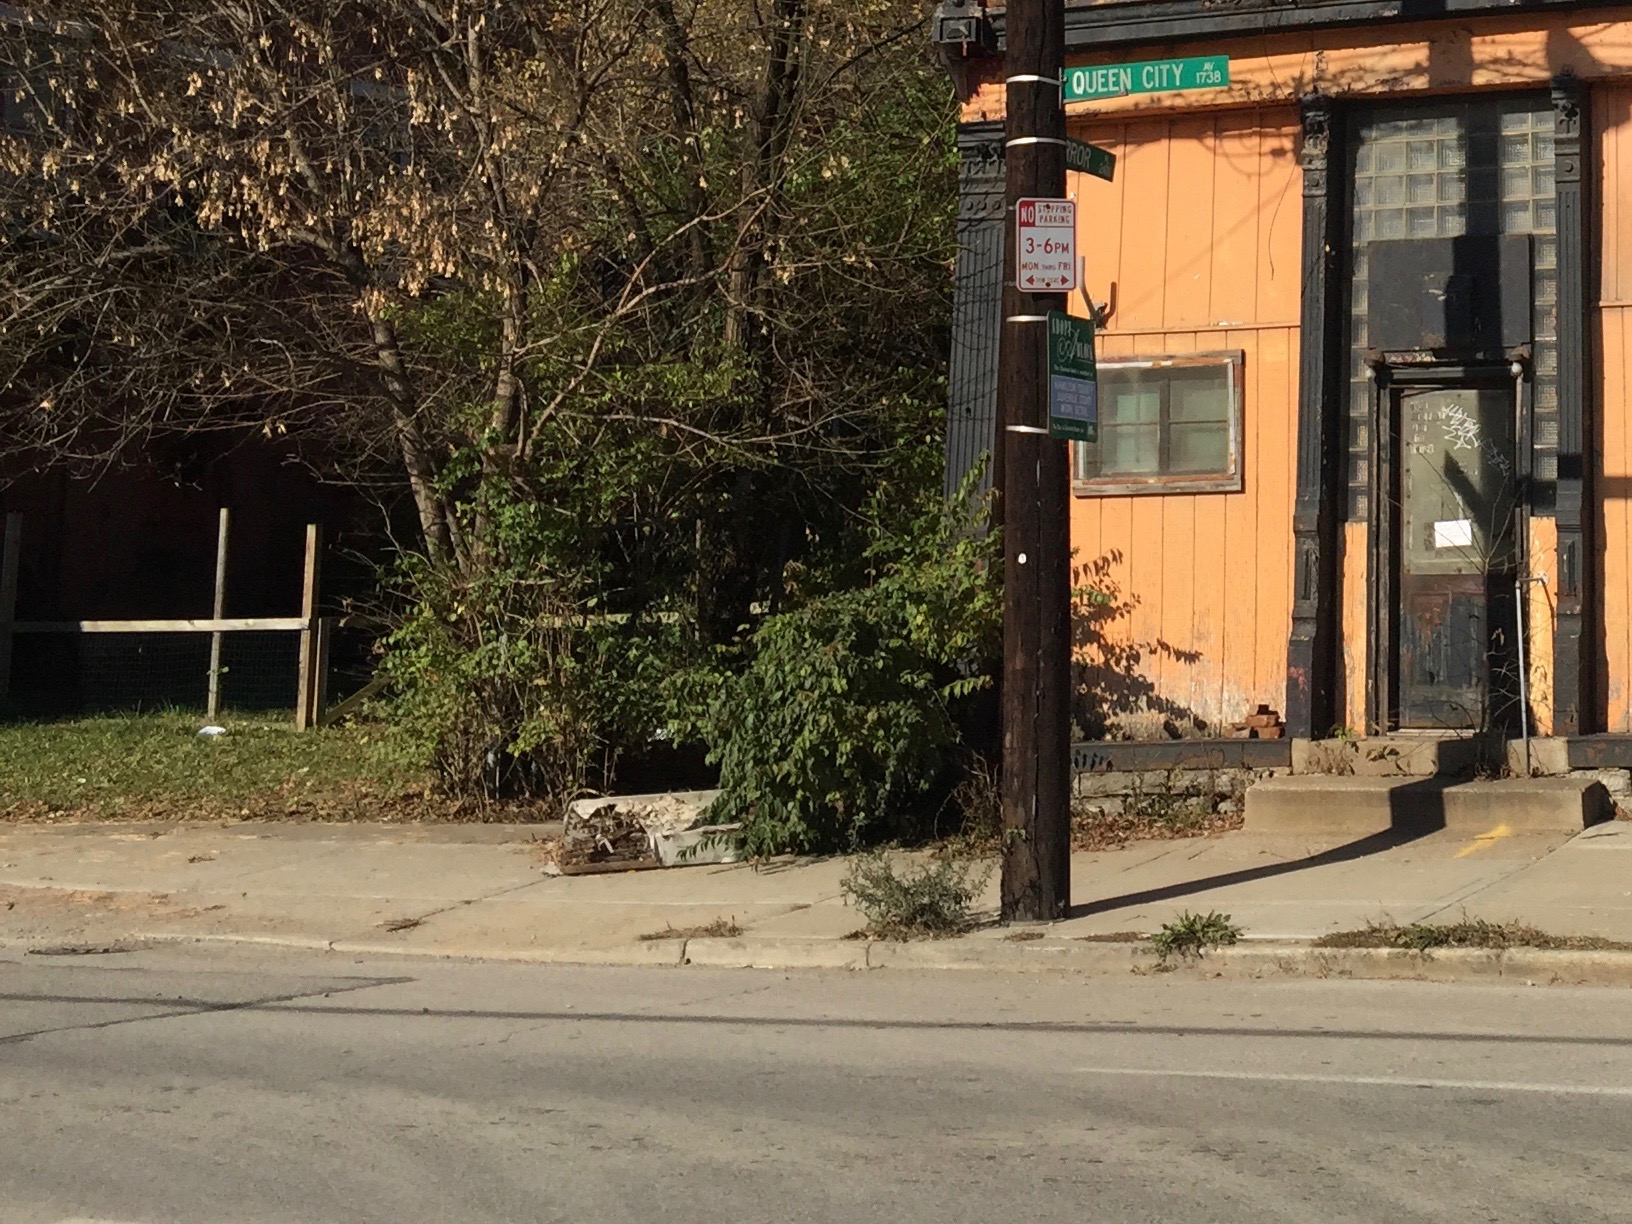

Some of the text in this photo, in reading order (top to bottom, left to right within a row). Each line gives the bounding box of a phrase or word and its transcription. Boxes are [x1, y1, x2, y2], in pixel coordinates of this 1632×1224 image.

[1072, 63, 1184, 95] QUEEN CITY
[1196, 70, 1222, 84] 1738
[1020, 206, 1035, 223] NO
[1039, 214, 1071, 224] PARKING
